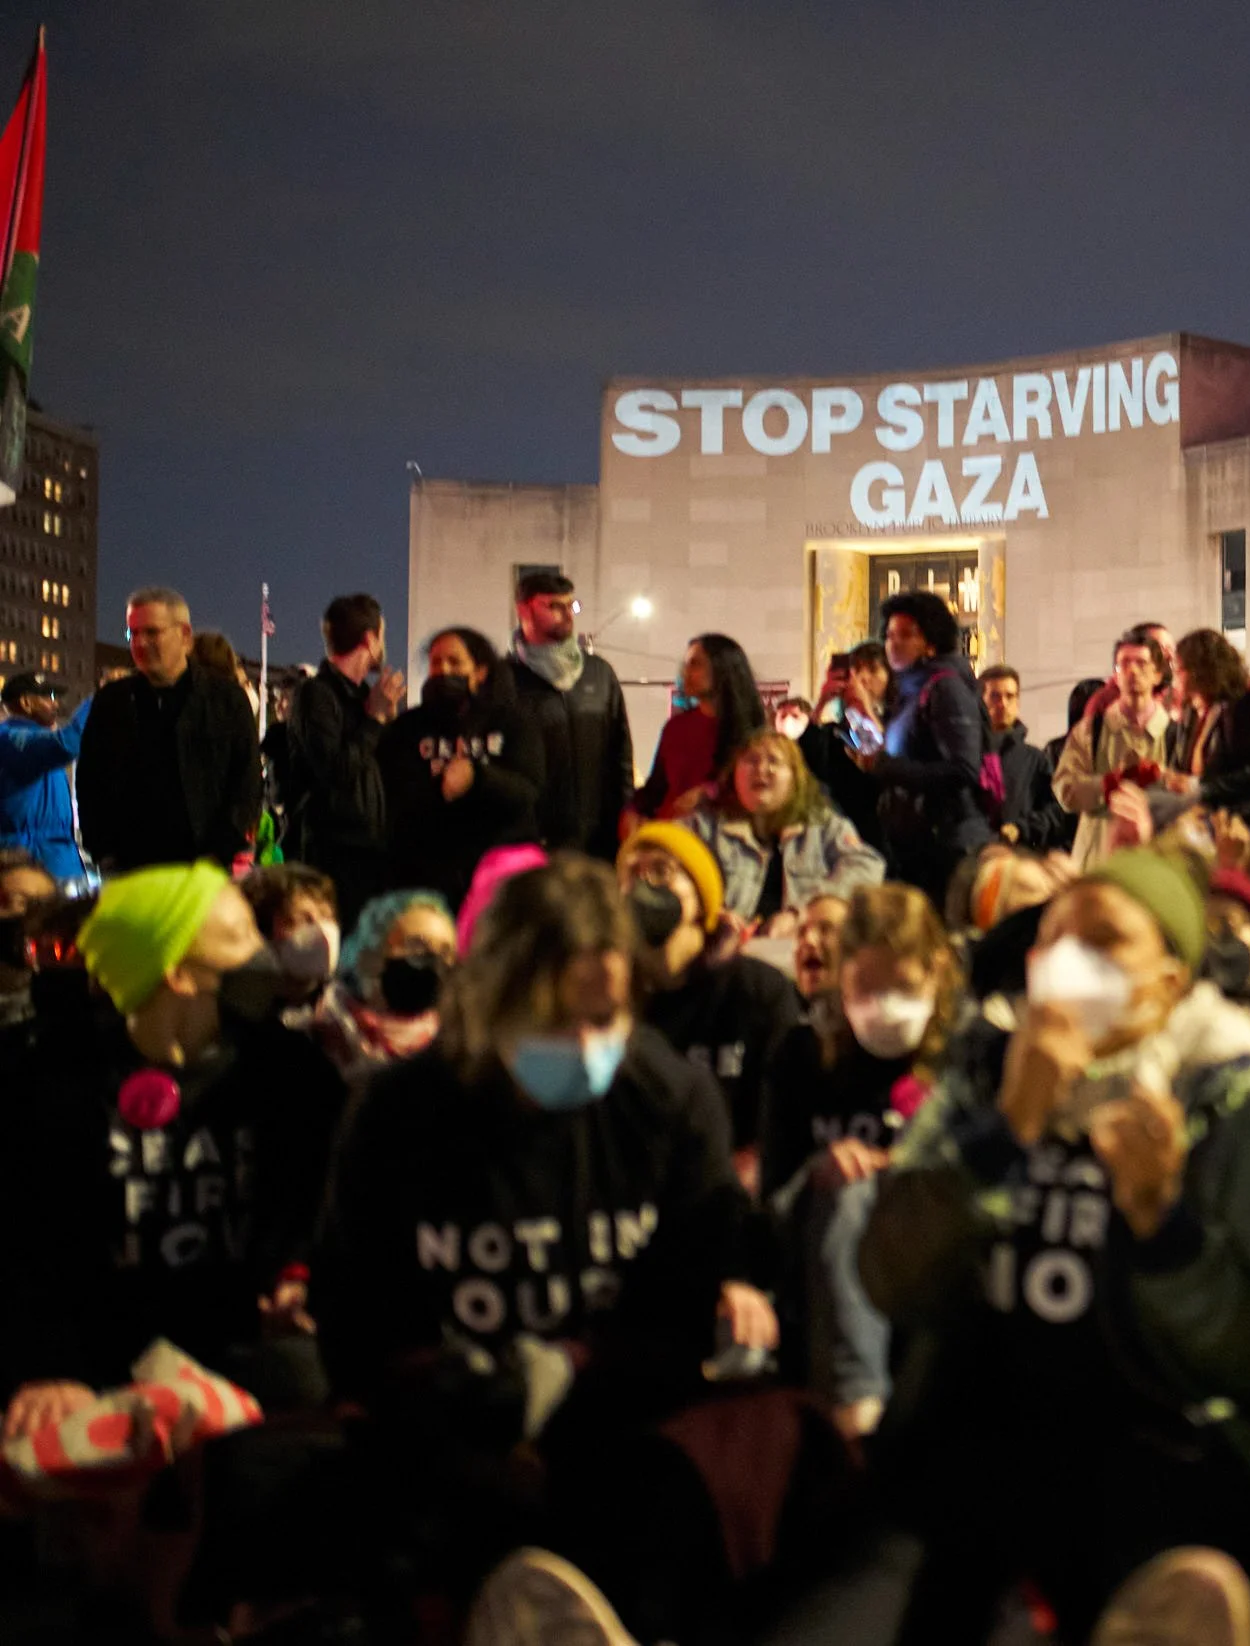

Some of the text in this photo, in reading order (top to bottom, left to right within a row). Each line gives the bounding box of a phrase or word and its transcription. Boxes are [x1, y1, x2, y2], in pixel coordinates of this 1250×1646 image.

[612, 351, 1181, 456] STOP STARVING
[850, 452, 1048, 524] GAZA
[416, 1202, 658, 1273] NOT IN
